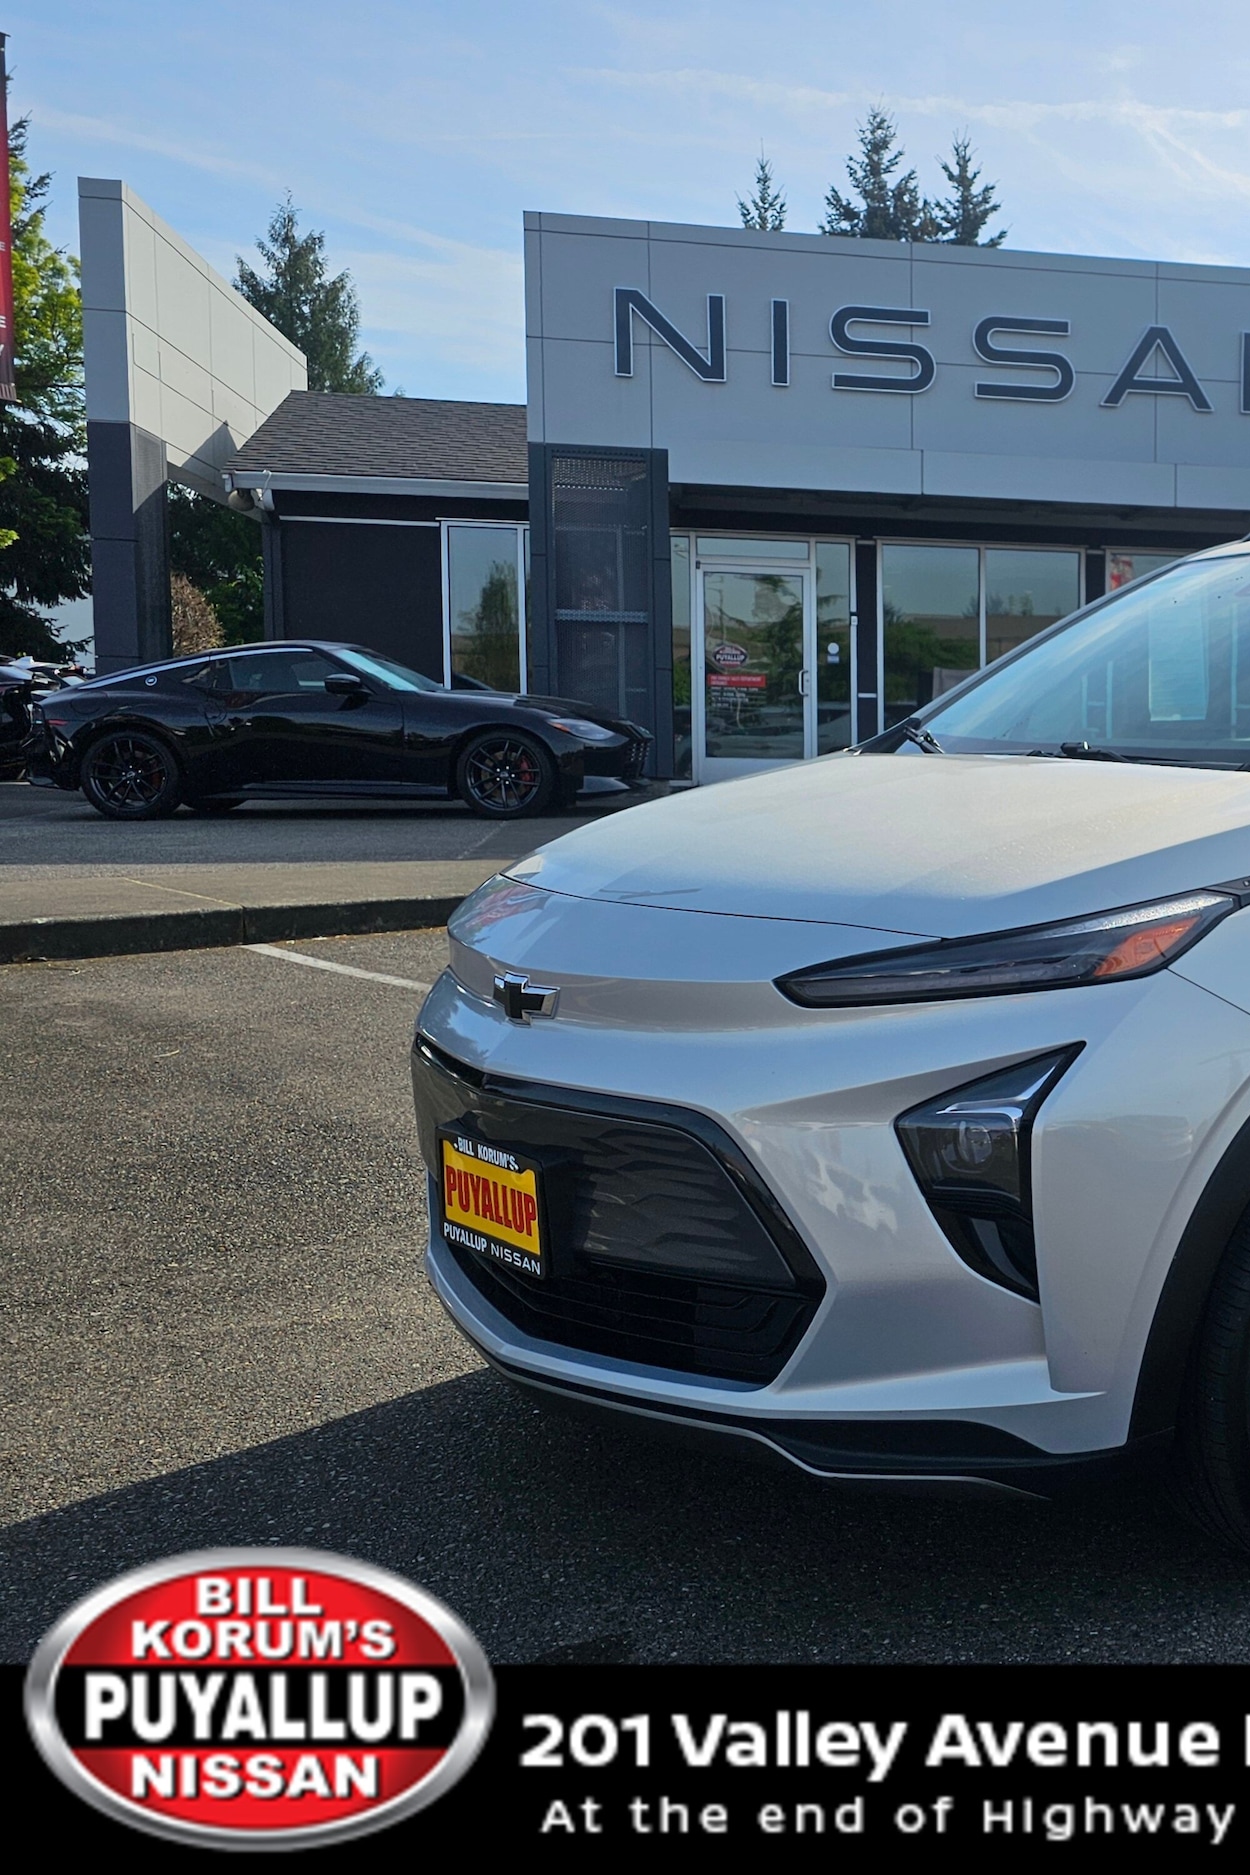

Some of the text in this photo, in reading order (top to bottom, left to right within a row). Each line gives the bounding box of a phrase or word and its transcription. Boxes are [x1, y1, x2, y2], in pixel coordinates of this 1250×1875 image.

[457, 1136, 517, 1170] BILL KORUM'S
[445, 1164, 538, 1238] PUYALLUP
[443, 1222, 541, 1276] PUYALLUP NISSAN
